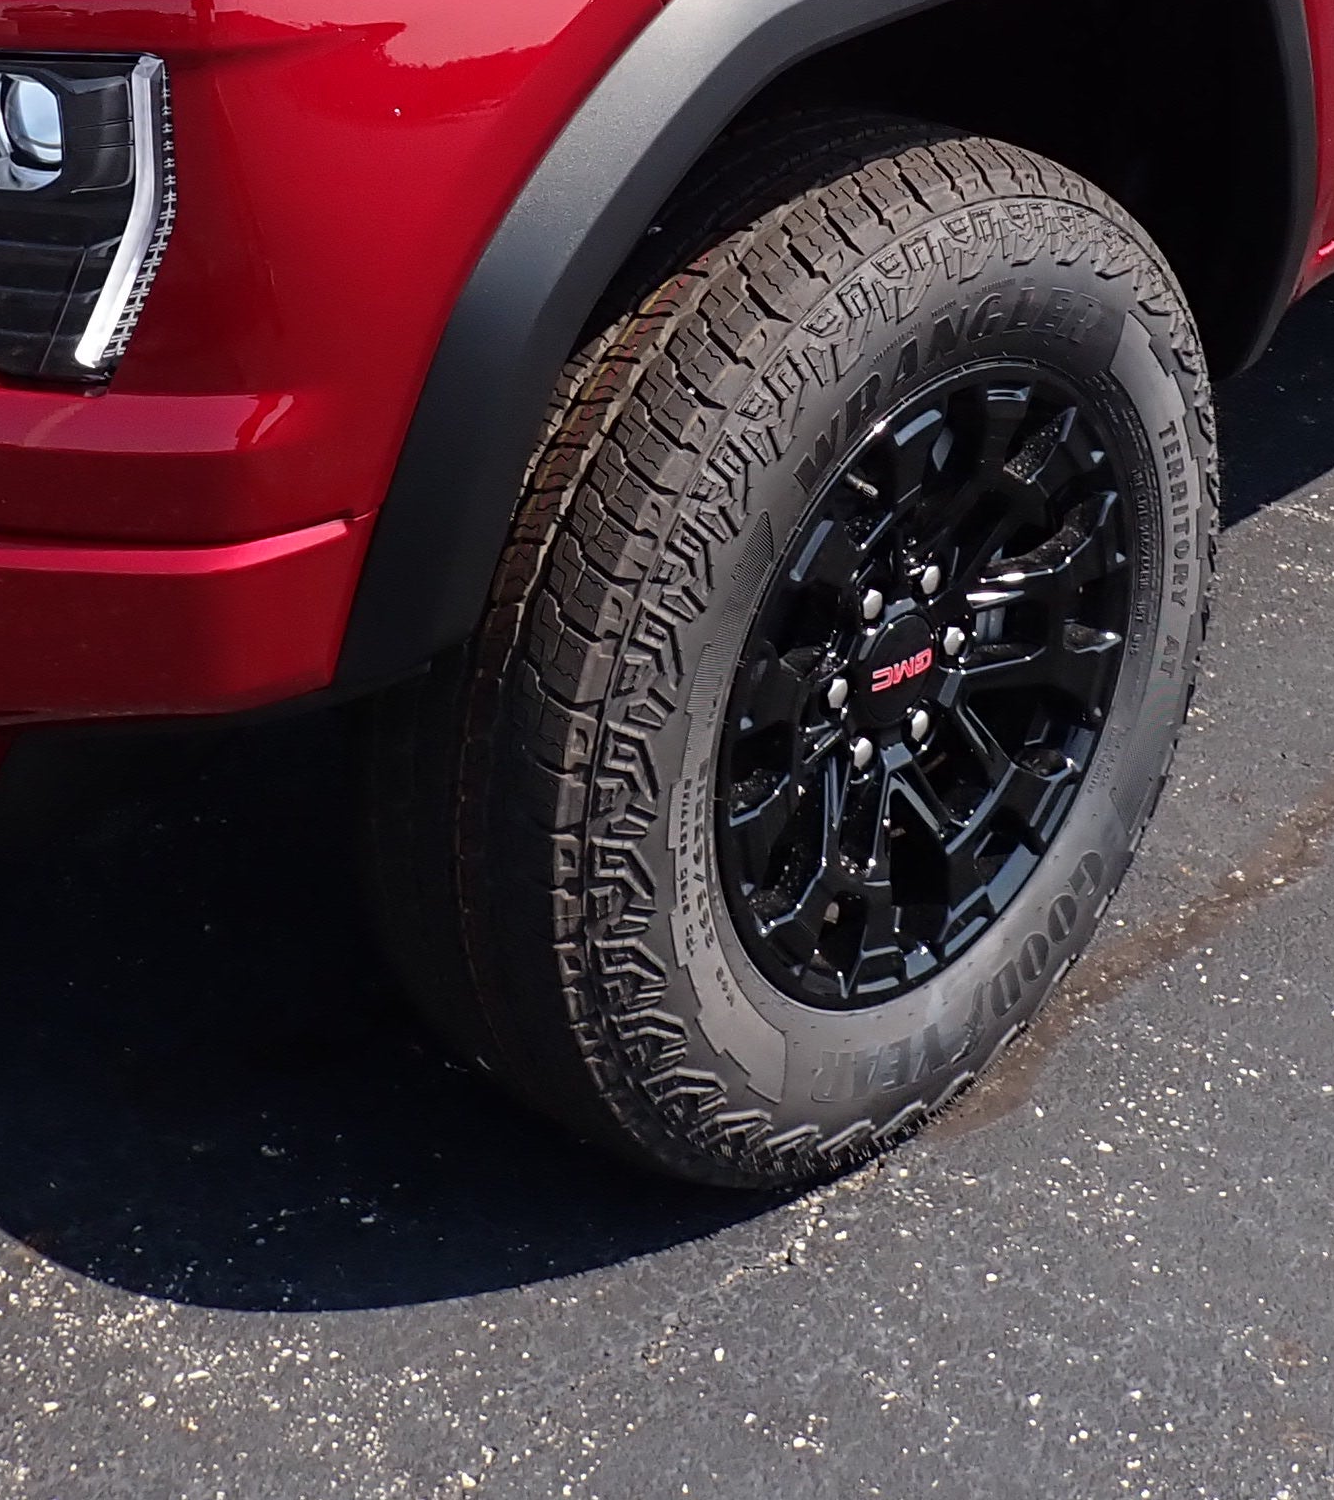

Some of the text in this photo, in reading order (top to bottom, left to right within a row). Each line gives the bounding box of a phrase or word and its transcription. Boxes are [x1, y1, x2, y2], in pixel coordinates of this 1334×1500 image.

[794, 285, 1101, 492] WRANGLER
[1158, 419, 1192, 678] TERRITORY AT
[871, 647, 932, 692] GMC
[812, 849, 1105, 1104] GOODYEAR
